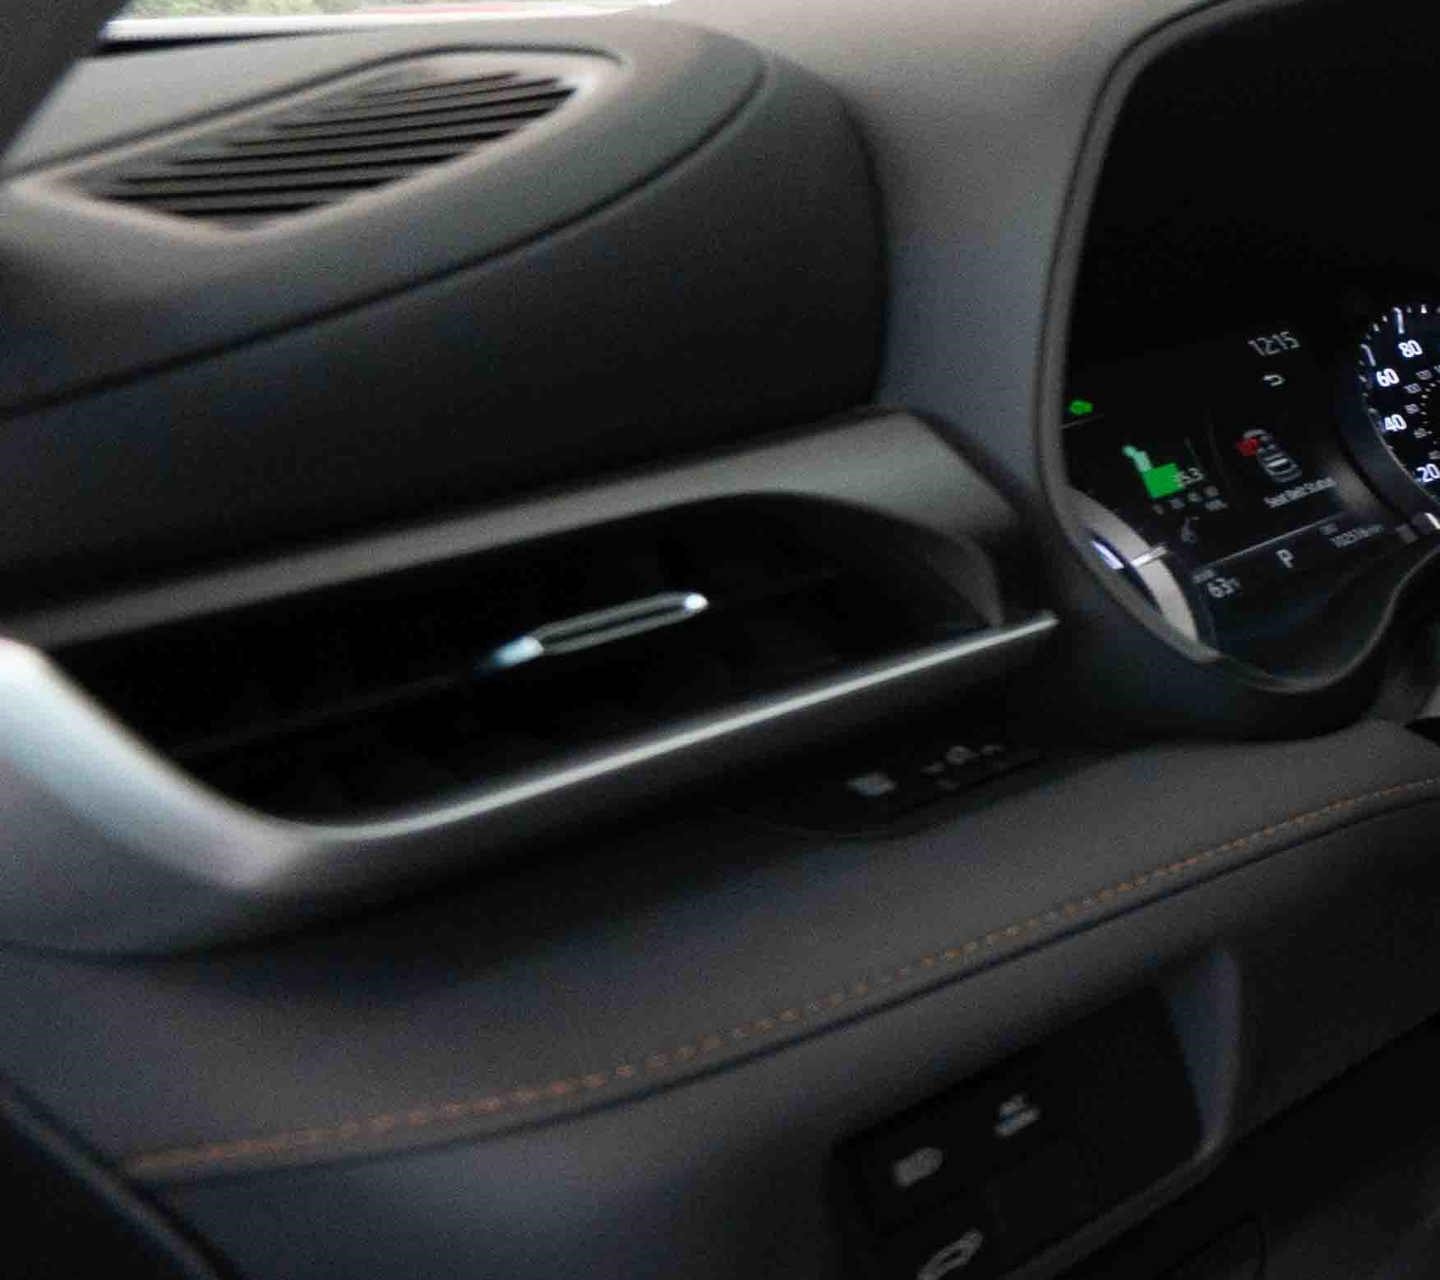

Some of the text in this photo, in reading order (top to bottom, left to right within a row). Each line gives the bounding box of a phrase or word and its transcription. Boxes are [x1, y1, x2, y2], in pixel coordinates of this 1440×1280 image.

[1399, 340, 1423, 358] 80
[1376, 368, 1400, 387] 60
[1384, 414, 1408, 433] 40
[1417, 463, 1440, 482] 20
